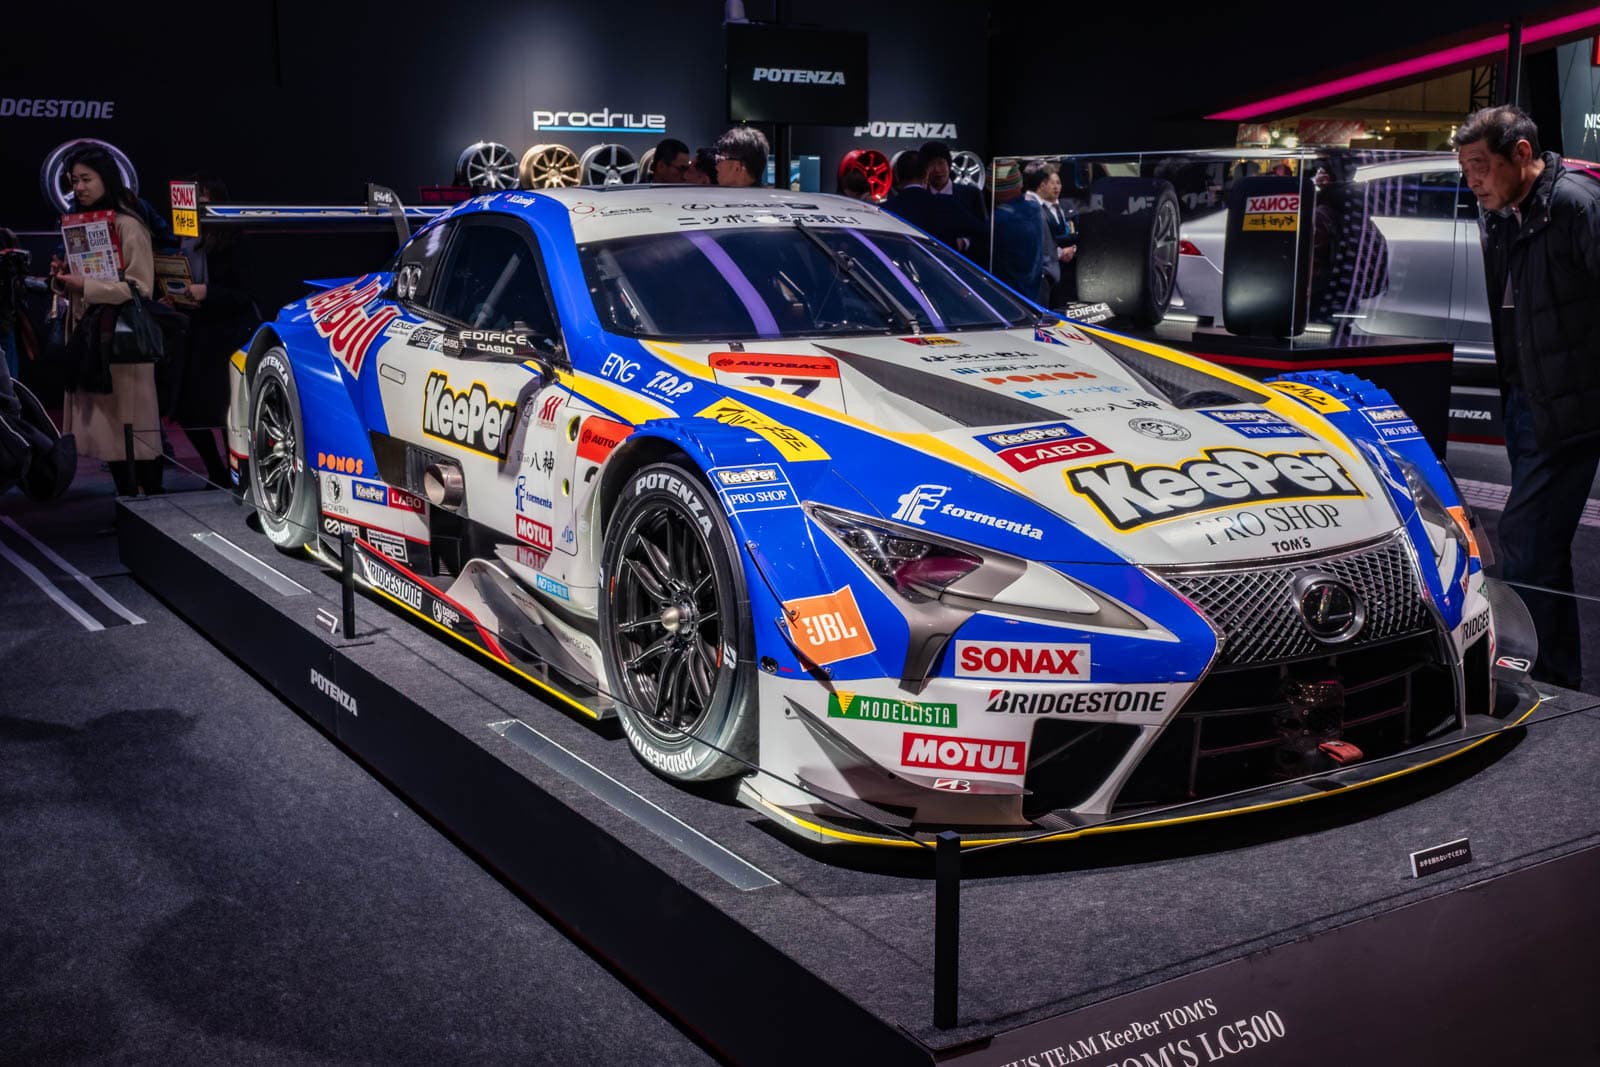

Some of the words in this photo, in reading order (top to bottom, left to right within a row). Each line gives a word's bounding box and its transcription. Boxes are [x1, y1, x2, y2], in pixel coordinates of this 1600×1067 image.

[752, 67, 846, 87] POTENZA
[0, 98, 115, 119] DGESTONE
[533, 107, 666, 131] prodrive
[854, 122, 958, 139] POTENZA
[171, 187, 195, 208] SONAX
[87, 229, 108, 241] EVENT
[1066, 302, 1110, 319] EDIFICE
[459, 330, 528, 346] EDIFICE
[476, 343, 515, 356] CASIO
[600, 352, 641, 384] ENG
[736, 359, 833, 371] AUTOBACS
[422, 371, 517, 458] KeePer
[988, 427, 1071, 447] KeePer
[1382, 428, 1399, 437] PRO
[1399, 425, 1419, 435] SHOP
[317, 452, 364, 475] PONOS
[1014, 442, 1097, 465] LABO
[717, 469, 778, 485] KeePer
[355, 483, 385, 503] KeePer
[391, 492, 422, 509] LABO
[525, 491, 553, 509] formenta
[730, 492, 756, 505] PRO
[758, 489, 788, 503] SHOP
[1067, 449, 1363, 532] KeePer
[634, 473, 713, 539] POTENZA
[939, 502, 1044, 541] formenta
[1207, 510, 1266, 546] PRO
[1272, 504, 1340, 533] SHOP
[518, 519, 552, 547] MOTUL
[370, 540, 405, 562] TRD
[1271, 535, 1311, 554] TOM'S
[806, 612, 858, 647] JBL
[960, 647, 1080, 675] SONAX
[310, 668, 358, 717] POTENZA
[985, 688, 1167, 714] BRIDGESTONE
[859, 698, 951, 726] MODELLISTA
[906, 737, 1019, 770] MOTUL
[1041, 1036, 1100, 1067] TEAM
[1098, 1020, 1162, 1051] KeePer
[1160, 998, 1218, 1031] TOM'S
[1196, 1010, 1285, 1062] LC500
